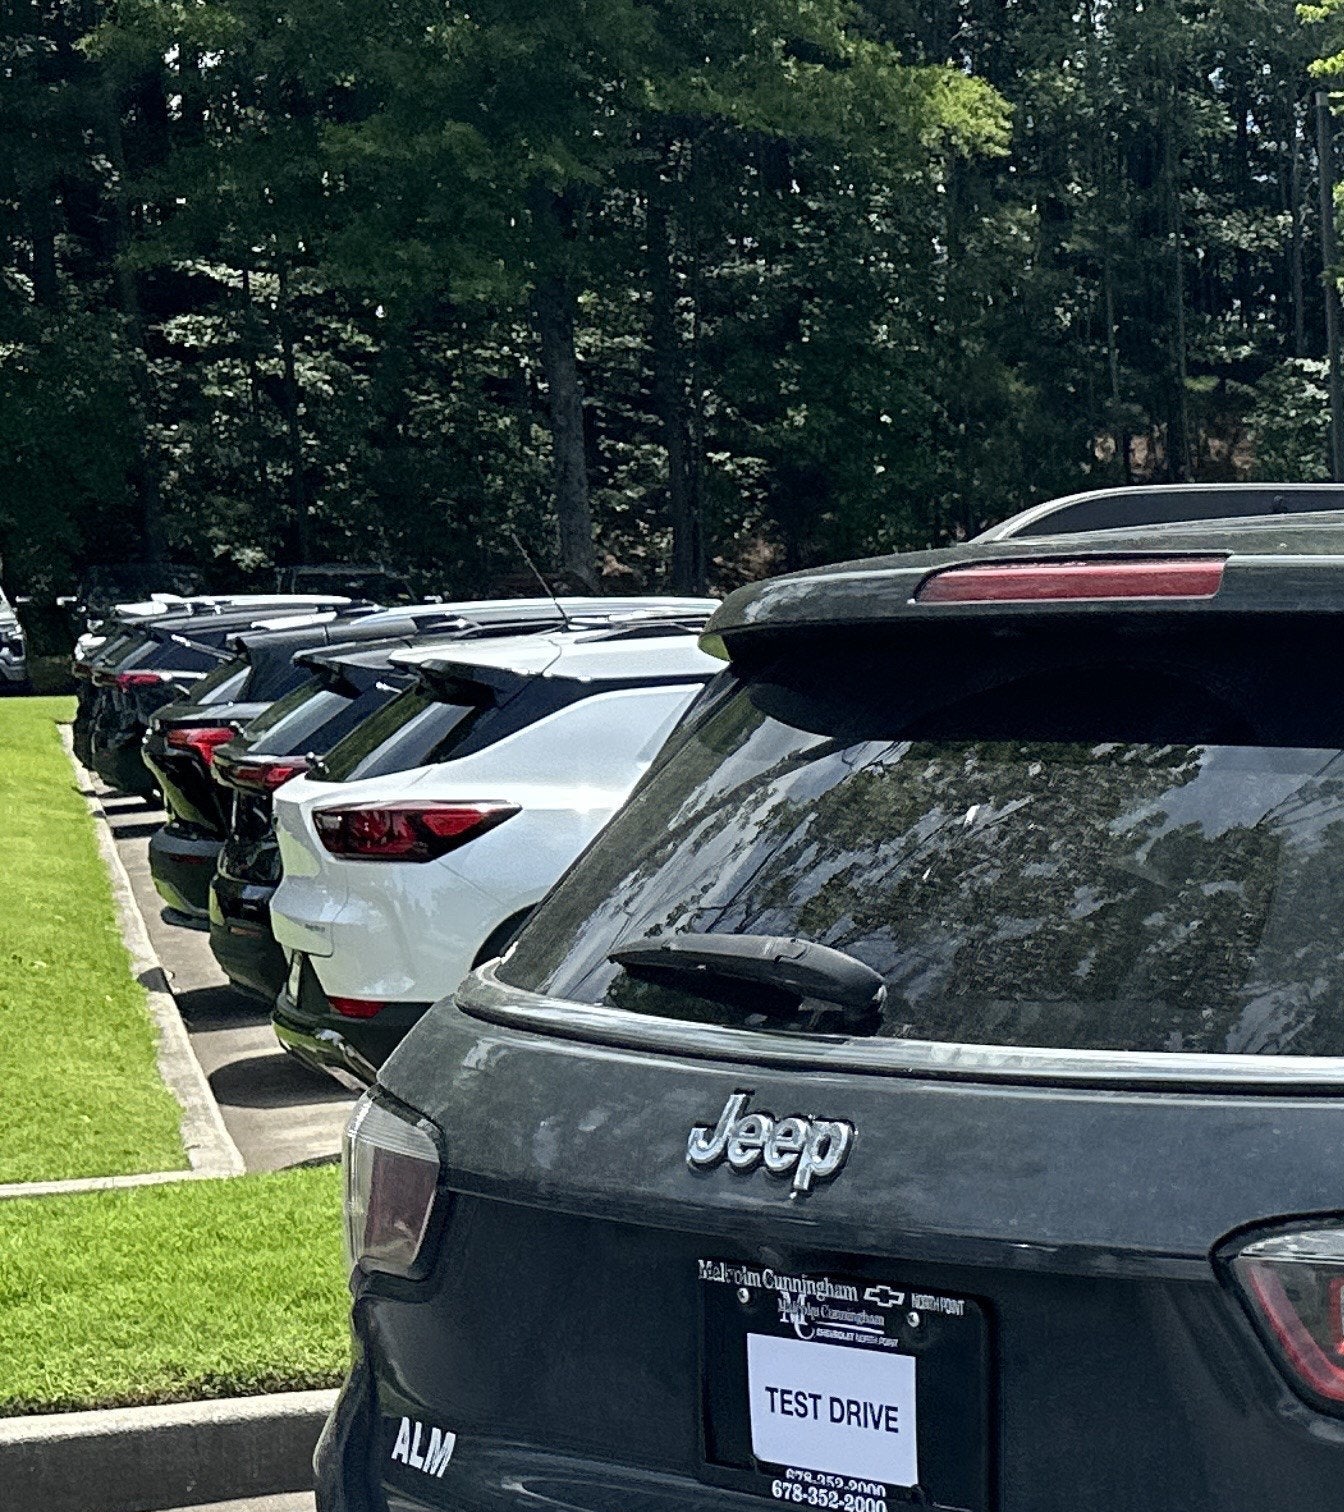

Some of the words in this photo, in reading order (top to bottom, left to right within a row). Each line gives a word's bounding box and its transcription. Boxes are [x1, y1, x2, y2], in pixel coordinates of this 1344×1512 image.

[687, 1094, 852, 1190] Jeep
[762, 1269, 858, 1301] Cunningham
[765, 1386, 822, 1421] TEST
[829, 1396, 899, 1433] DRIVE
[391, 1416, 457, 1478] ALM
